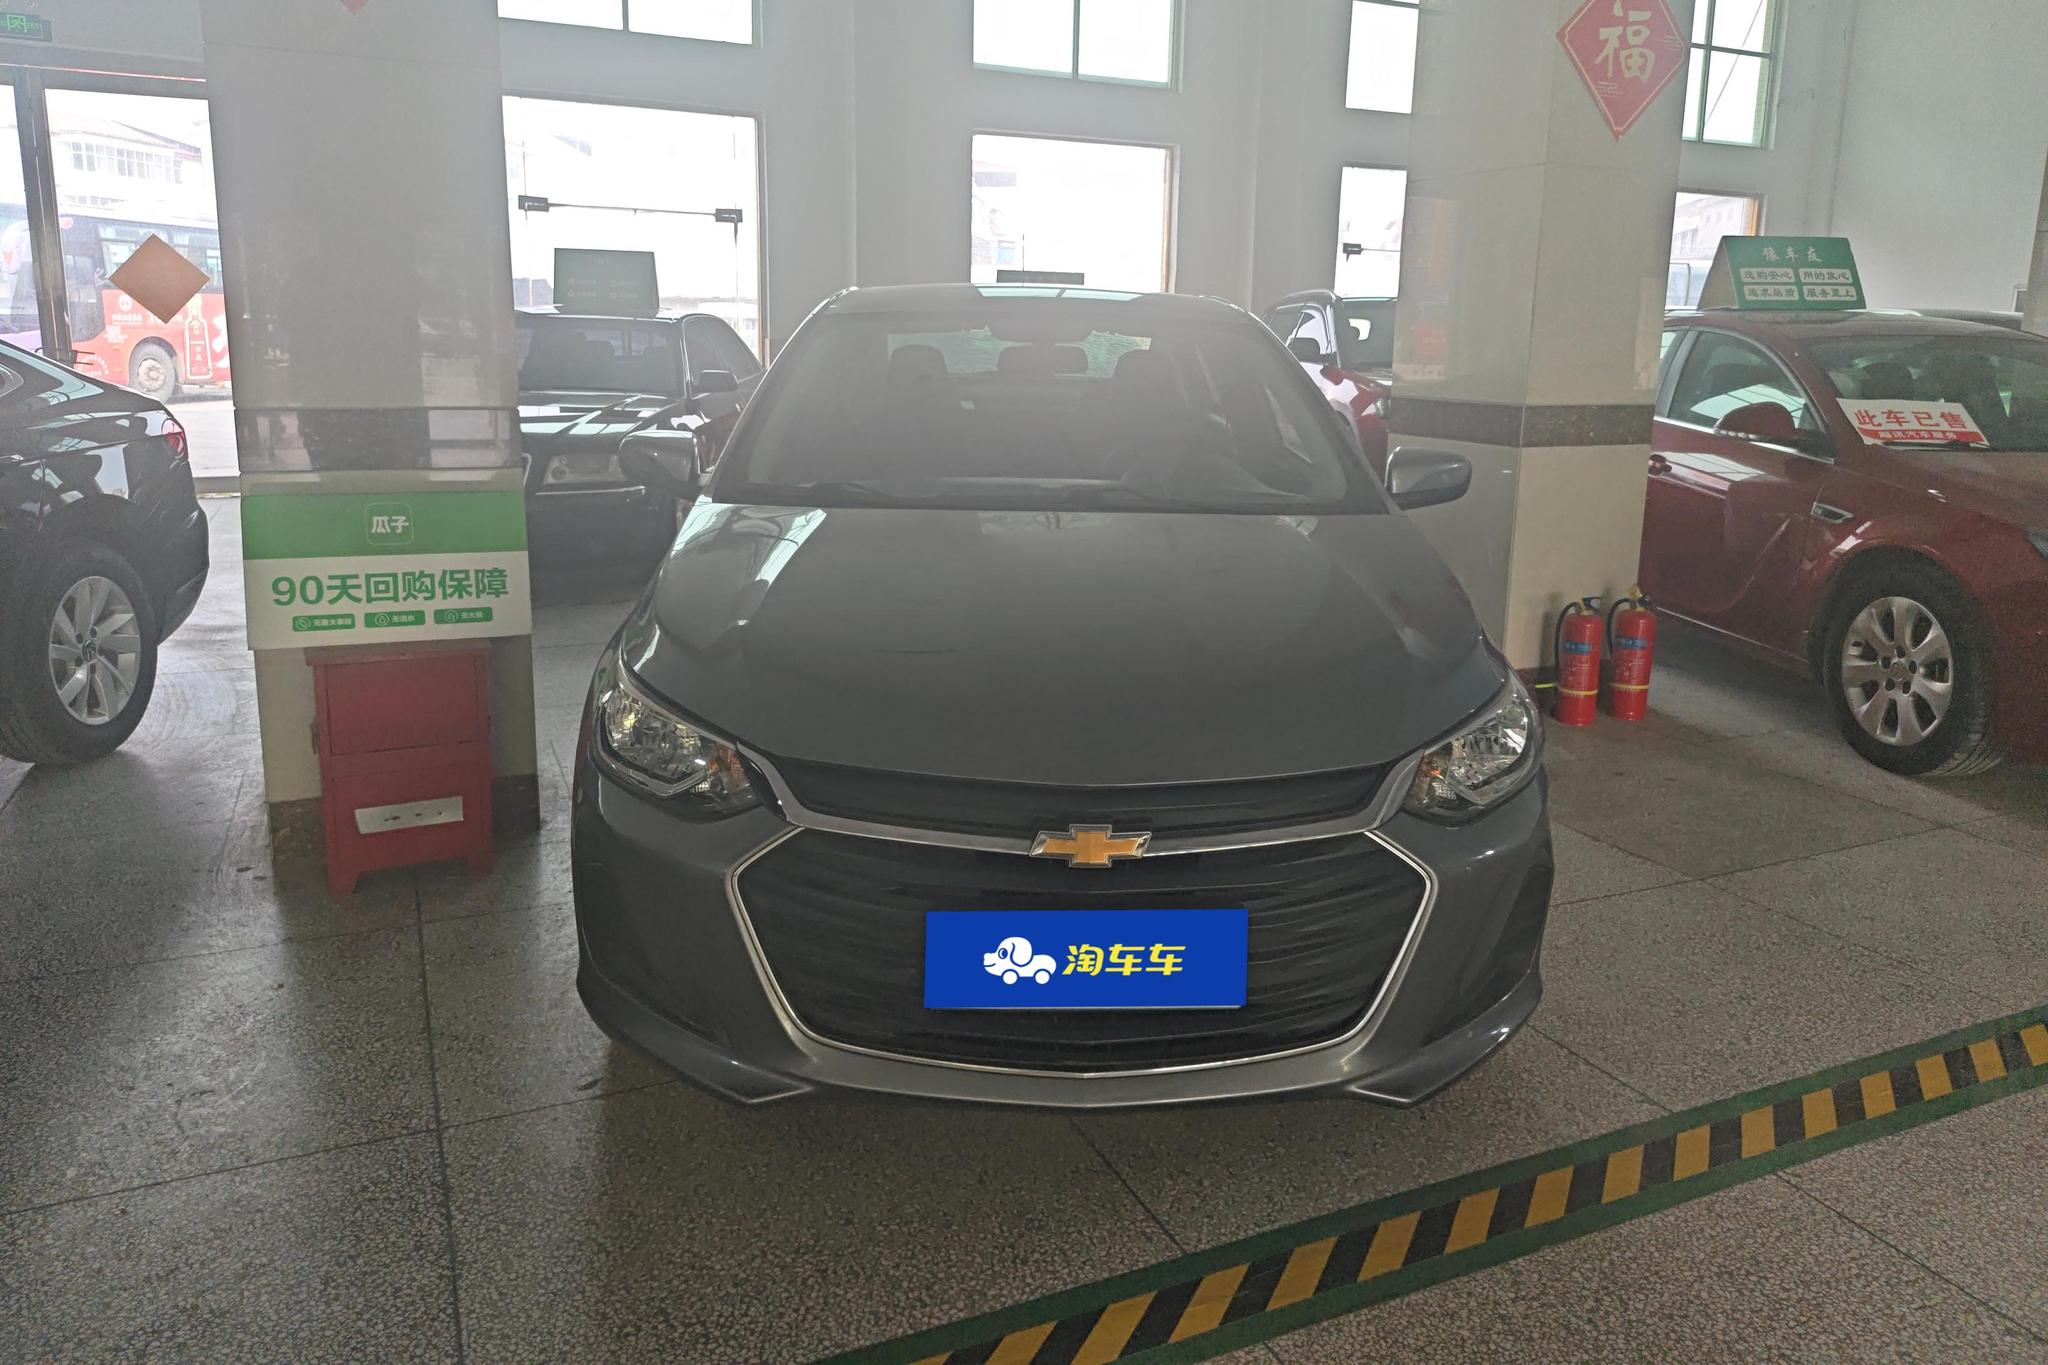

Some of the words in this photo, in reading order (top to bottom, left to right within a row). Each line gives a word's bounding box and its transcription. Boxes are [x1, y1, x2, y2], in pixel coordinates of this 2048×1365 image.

[1593, 0, 1656, 83] 福
[1802, 270, 1851, 281] 用的放心
[1855, 409, 1968, 430] 此车已售
[371, 516, 410, 534] 瓜子
[271, 566, 509, 607] 90天回购保障
